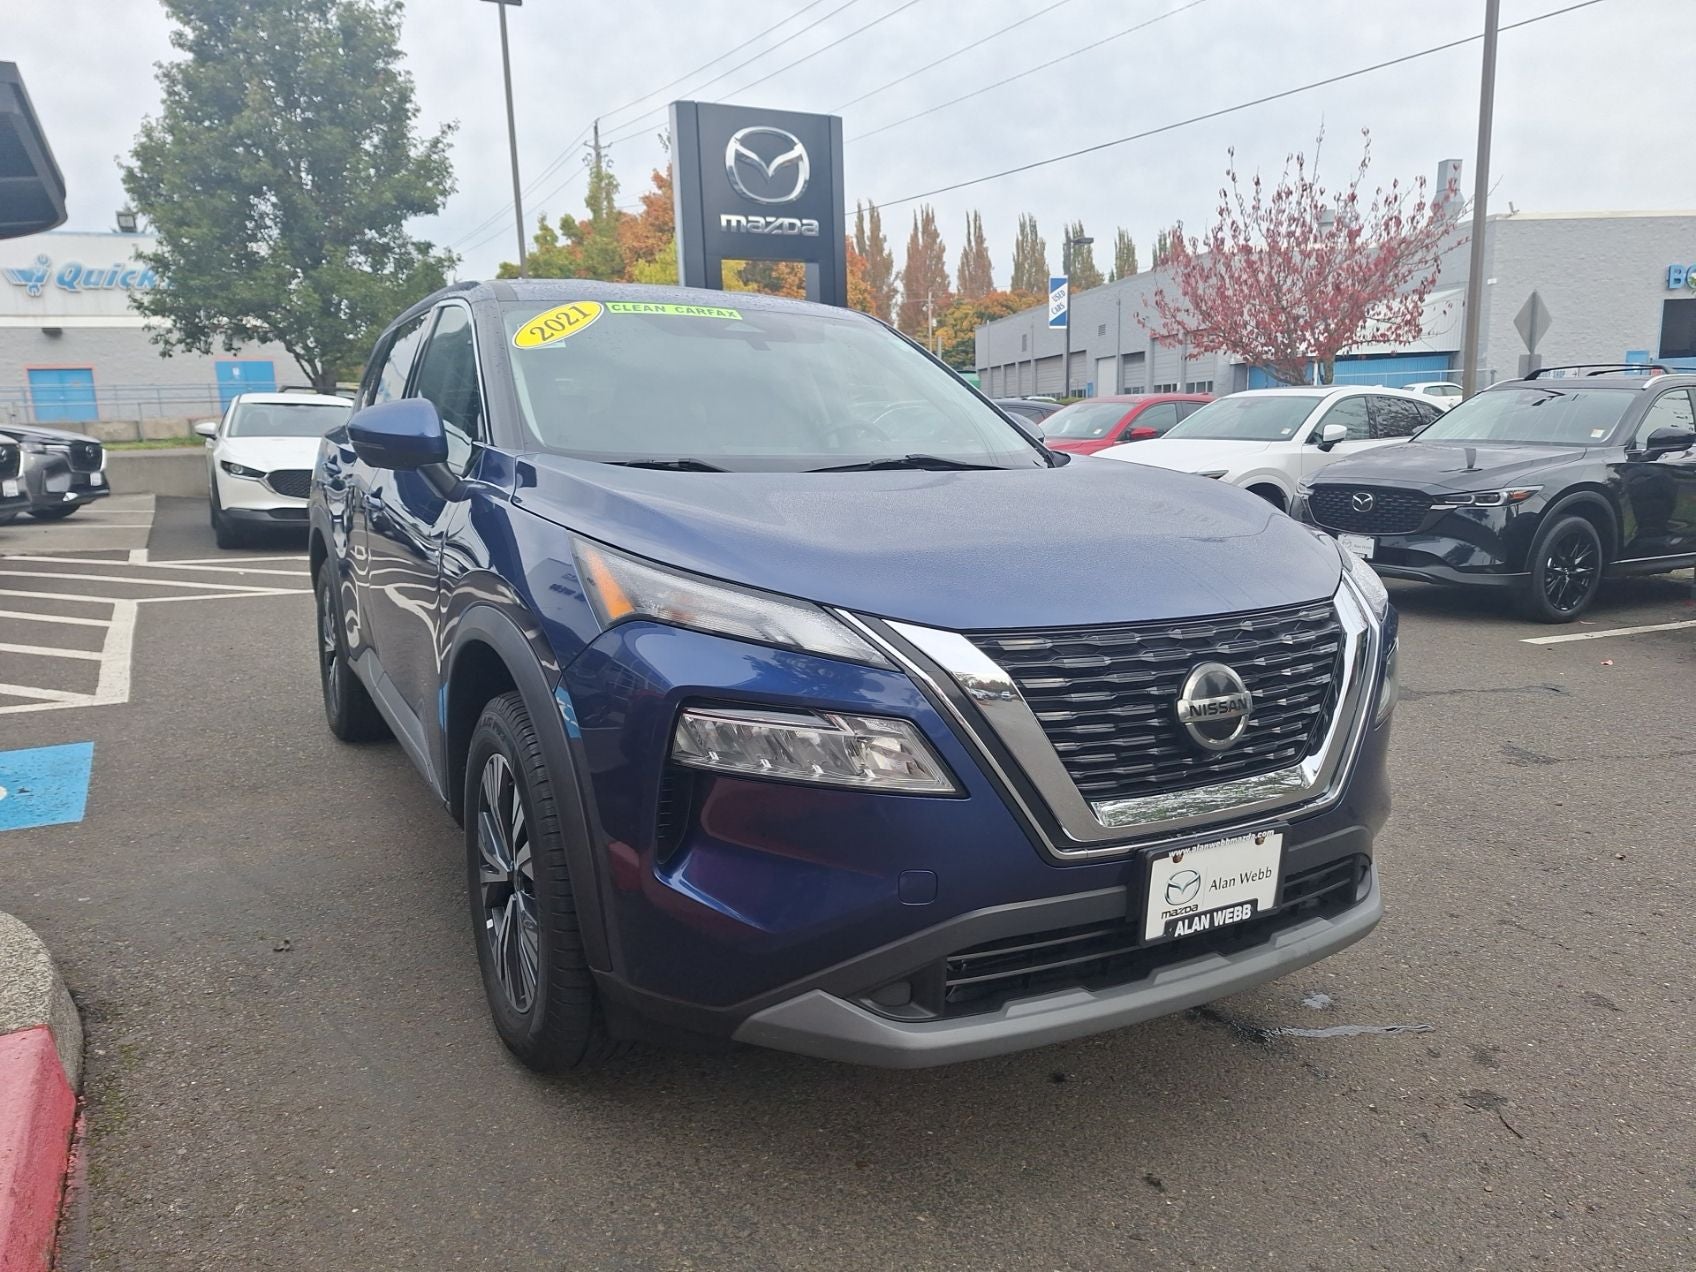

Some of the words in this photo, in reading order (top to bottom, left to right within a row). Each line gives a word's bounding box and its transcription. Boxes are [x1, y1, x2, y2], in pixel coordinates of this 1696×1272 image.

[56, 261, 157, 293] Quick
[1051, 289, 1066, 303] USED
[611, 304, 666, 313] CLEAN
[675, 306, 737, 318] CARFAX
[1051, 302, 1066, 315] CARS
[530, 305, 591, 341] 2021
[1189, 698, 1248, 717] NISSAN
[1209, 876, 1236, 893] Alan
[1239, 867, 1272, 885] Webb
[1174, 913, 1211, 937] ALAN
[1213, 904, 1252, 927] WEBB
